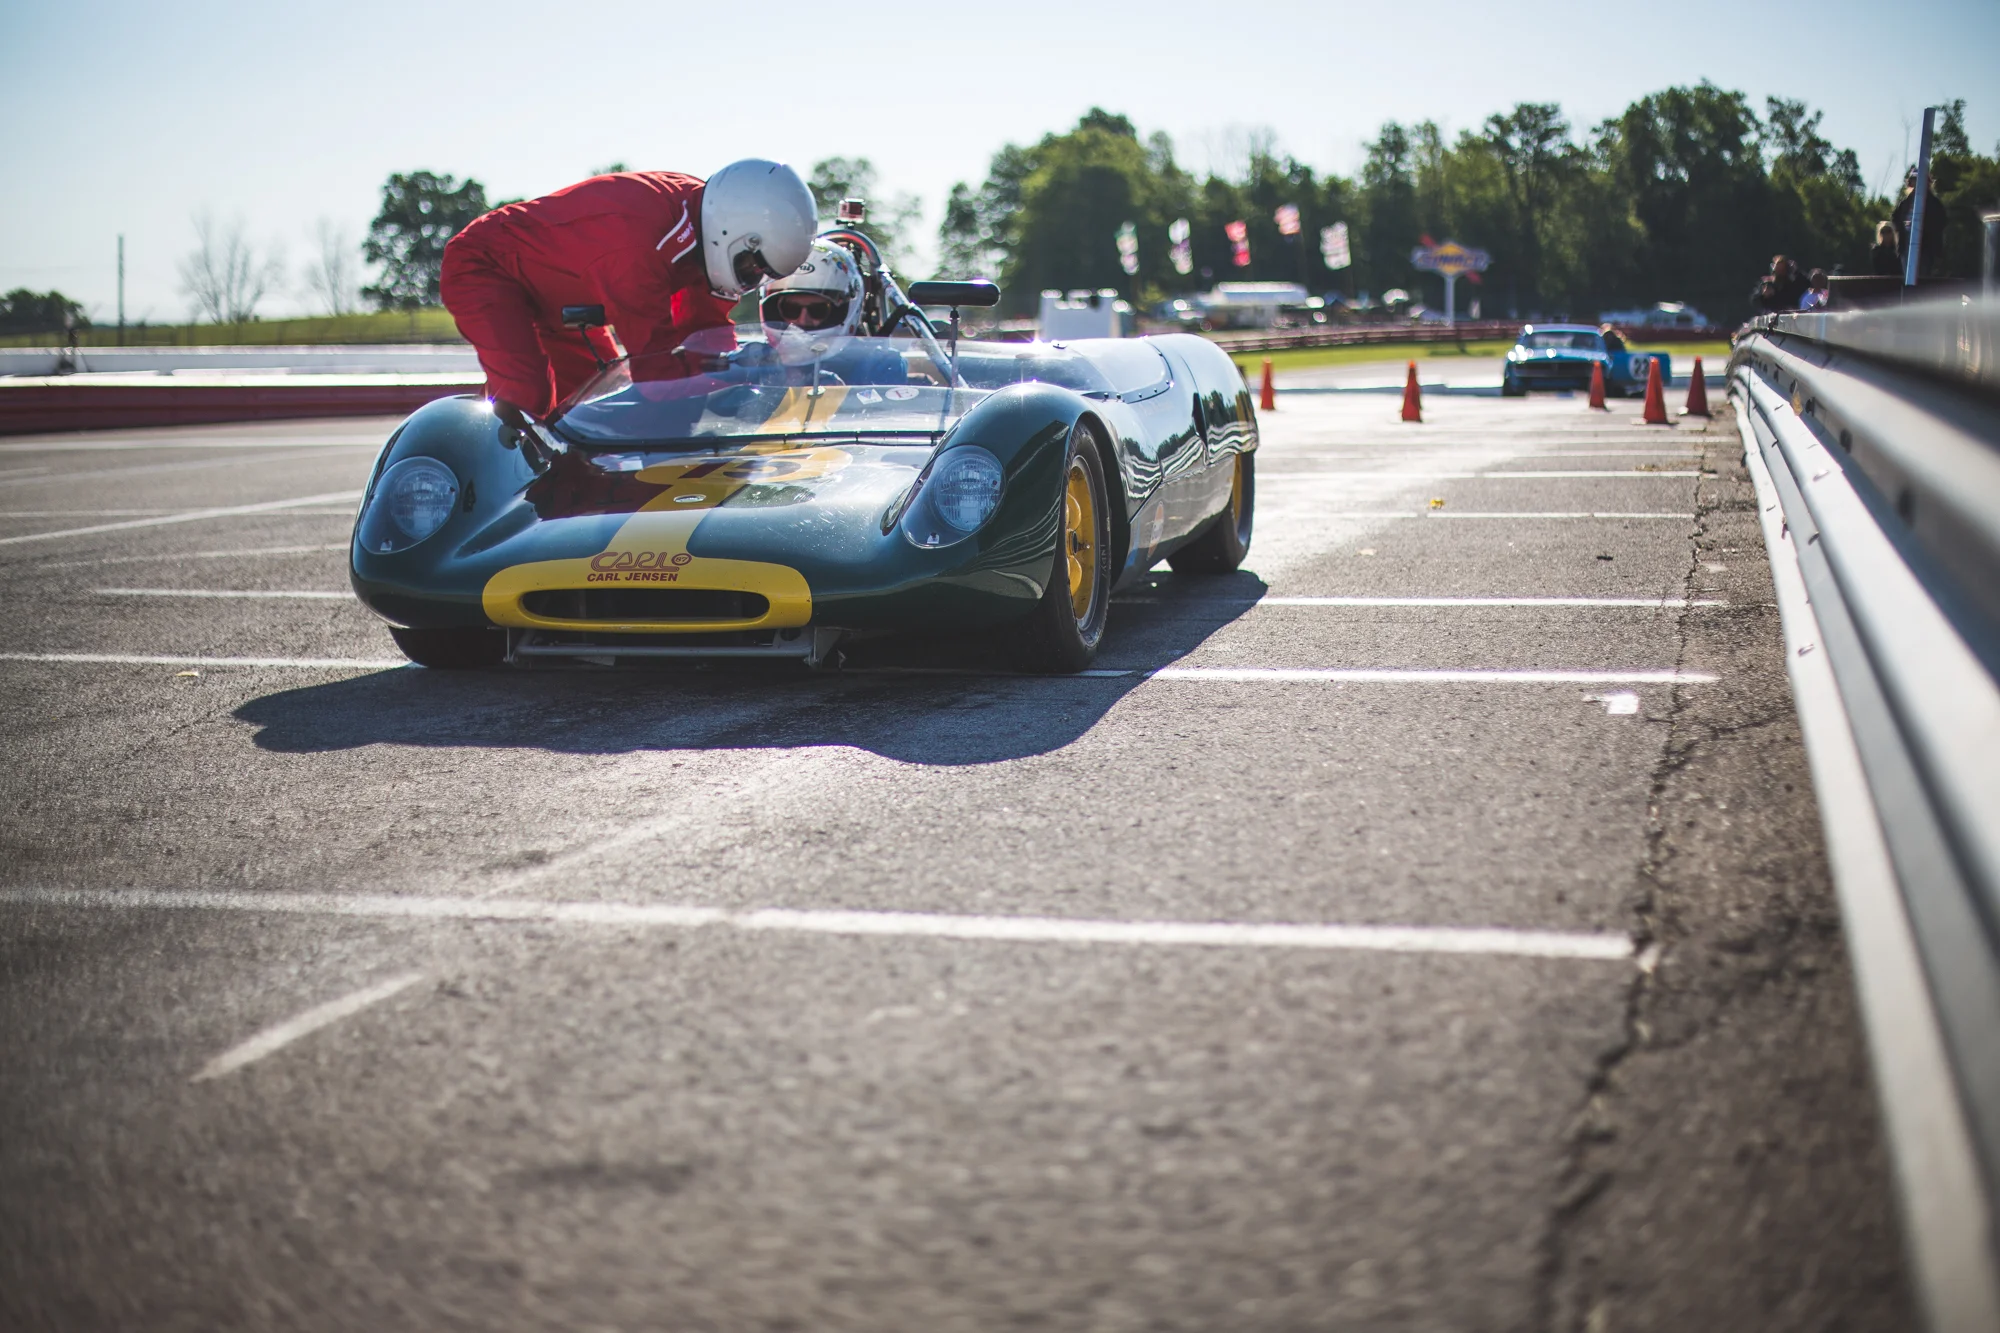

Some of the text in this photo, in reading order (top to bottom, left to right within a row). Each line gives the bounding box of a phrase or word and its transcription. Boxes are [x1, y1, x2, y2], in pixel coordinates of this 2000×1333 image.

[590, 551, 680, 573] CARL
[587, 572, 679, 582] CARL JENSEN
